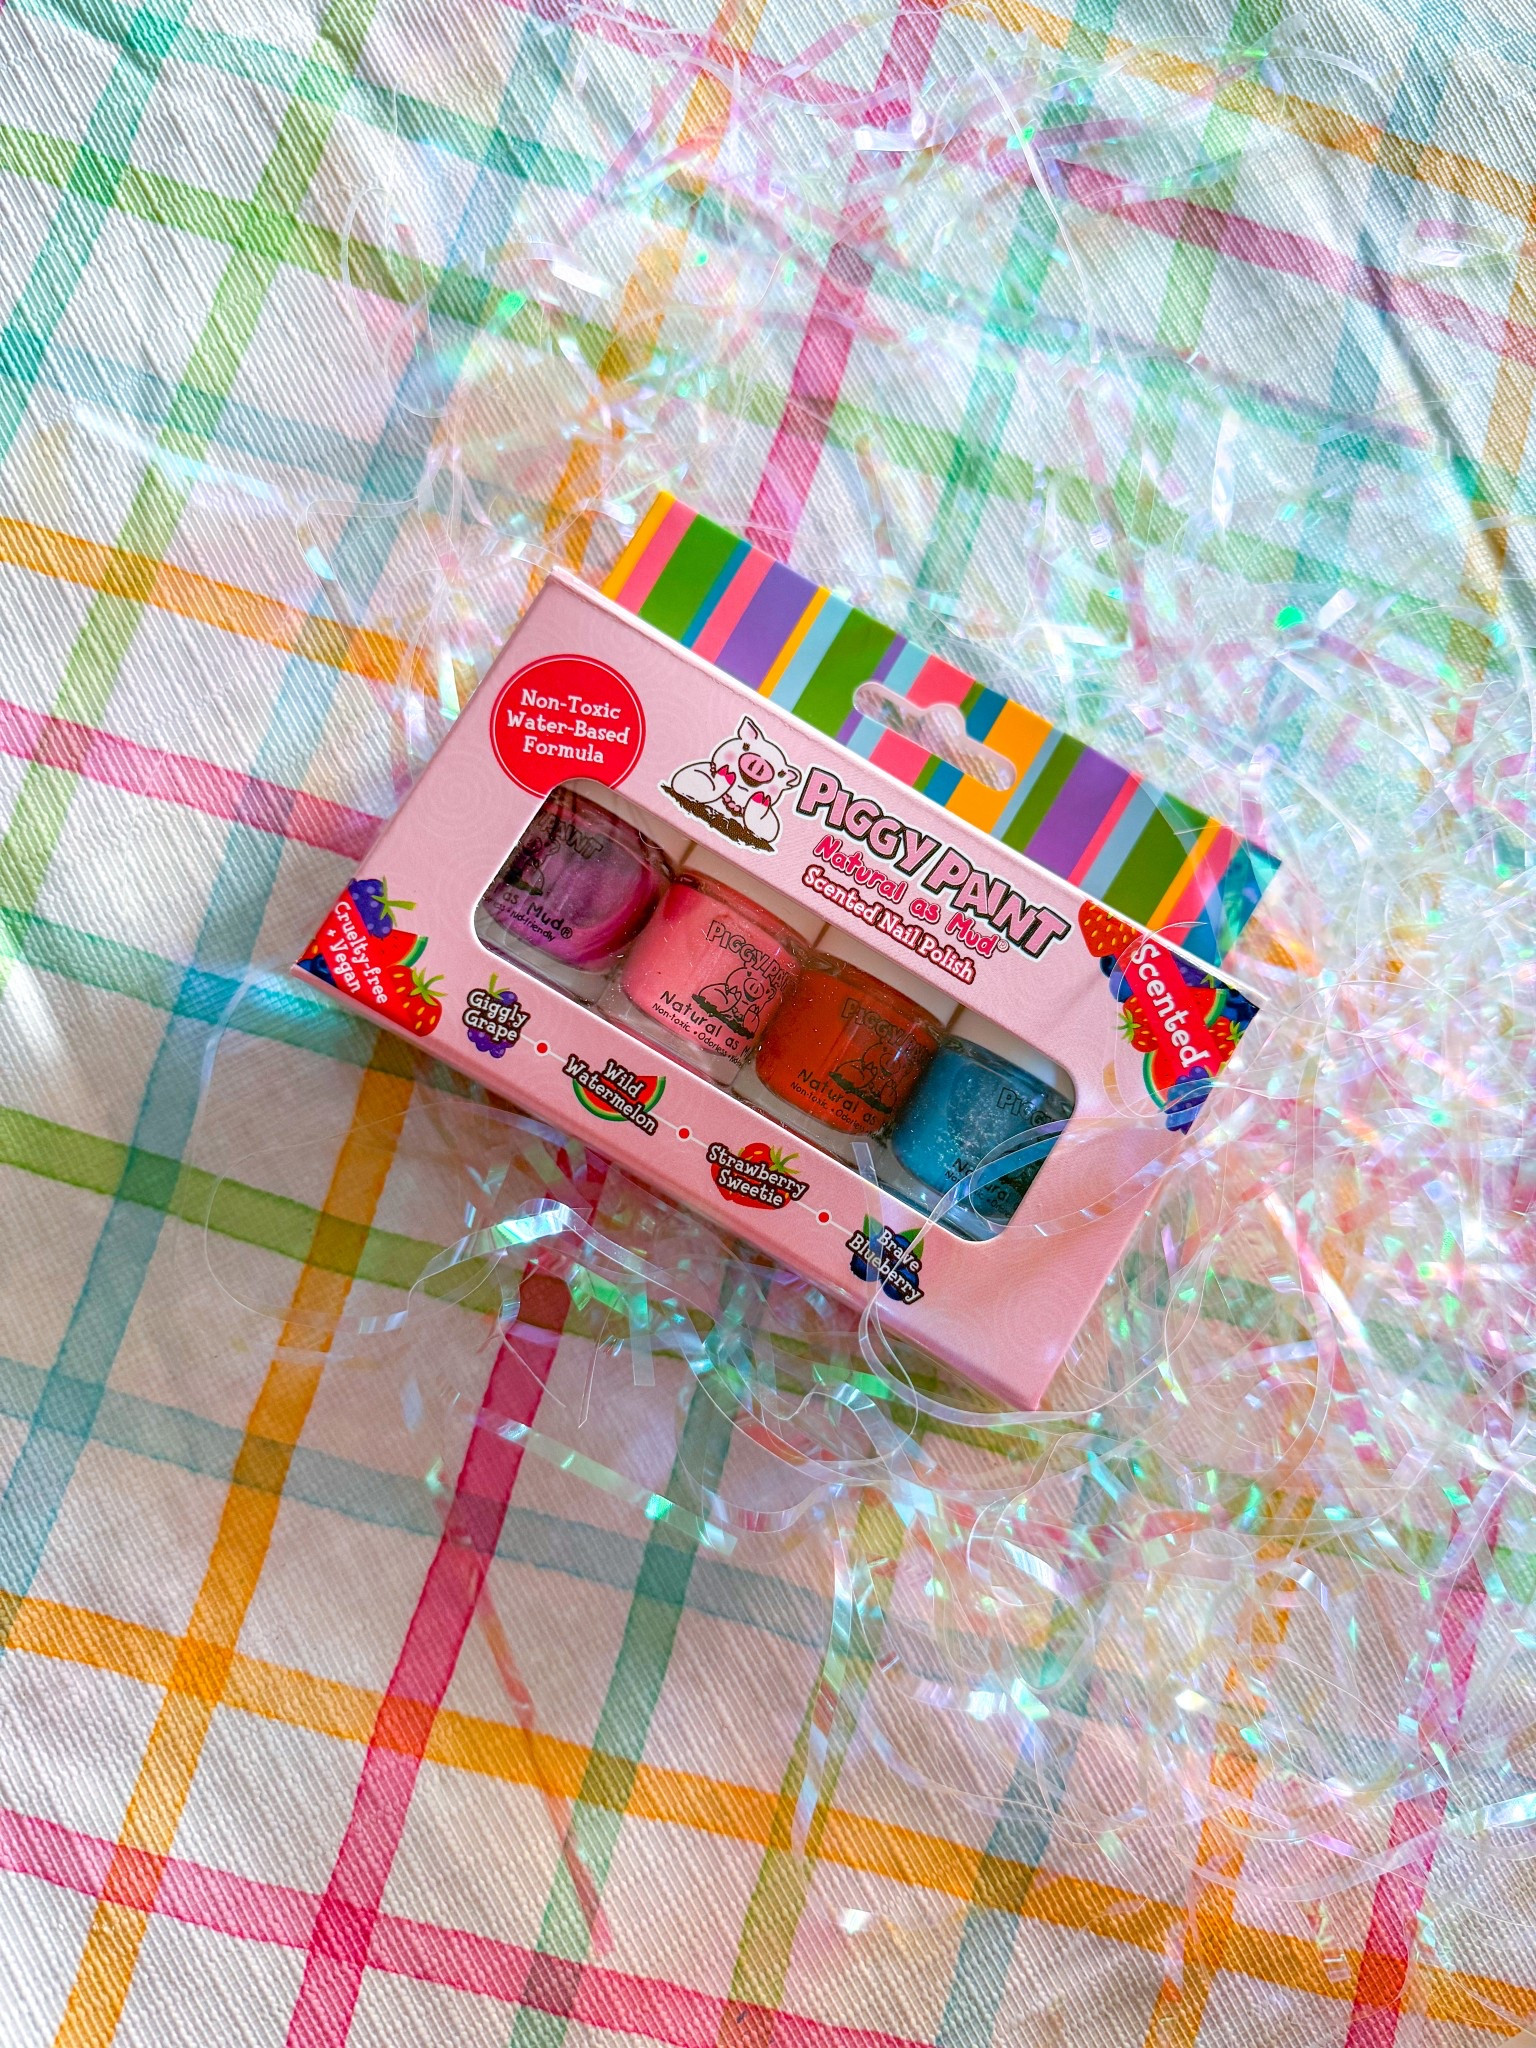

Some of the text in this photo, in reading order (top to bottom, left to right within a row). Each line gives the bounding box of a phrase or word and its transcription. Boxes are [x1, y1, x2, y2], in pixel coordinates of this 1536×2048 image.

[506, 709, 631, 745] Water-Based
[520, 688, 622, 719] Non-Toxic
[522, 735, 604, 764] Formula
[796, 767, 1072, 959] PIGGY PAINT
[813, 834, 908, 904] Natural
[909, 898, 941, 924] as
[706, 920, 770, 970] PIGGY
[802, 864, 976, 985] Scented Nail Polish
[329, 938, 362, 993] Vegan
[334, 901, 388, 1004] Cruelty-free
[464, 1010, 518, 1041] Grape
[468, 990, 529, 1028] Giggly
[652, 1002, 690, 1033] Non-toxic
[660, 990, 739, 1050] Natural as
[1131, 943, 1211, 1068] Scented
[564, 1056, 658, 1133] Watermelon
[603, 1059, 645, 1098] Wild
[790, 1081, 828, 1110] Non-toxic
[798, 1068, 876, 1126] Natural as
[997, 1087, 1054, 1127] PIGG
[708, 1144, 807, 1199] Strawberry
[717, 1168, 783, 1206] Sweetie
[848, 1234, 922, 1303] Blueberry
[876, 1228, 921, 1272] Brave
